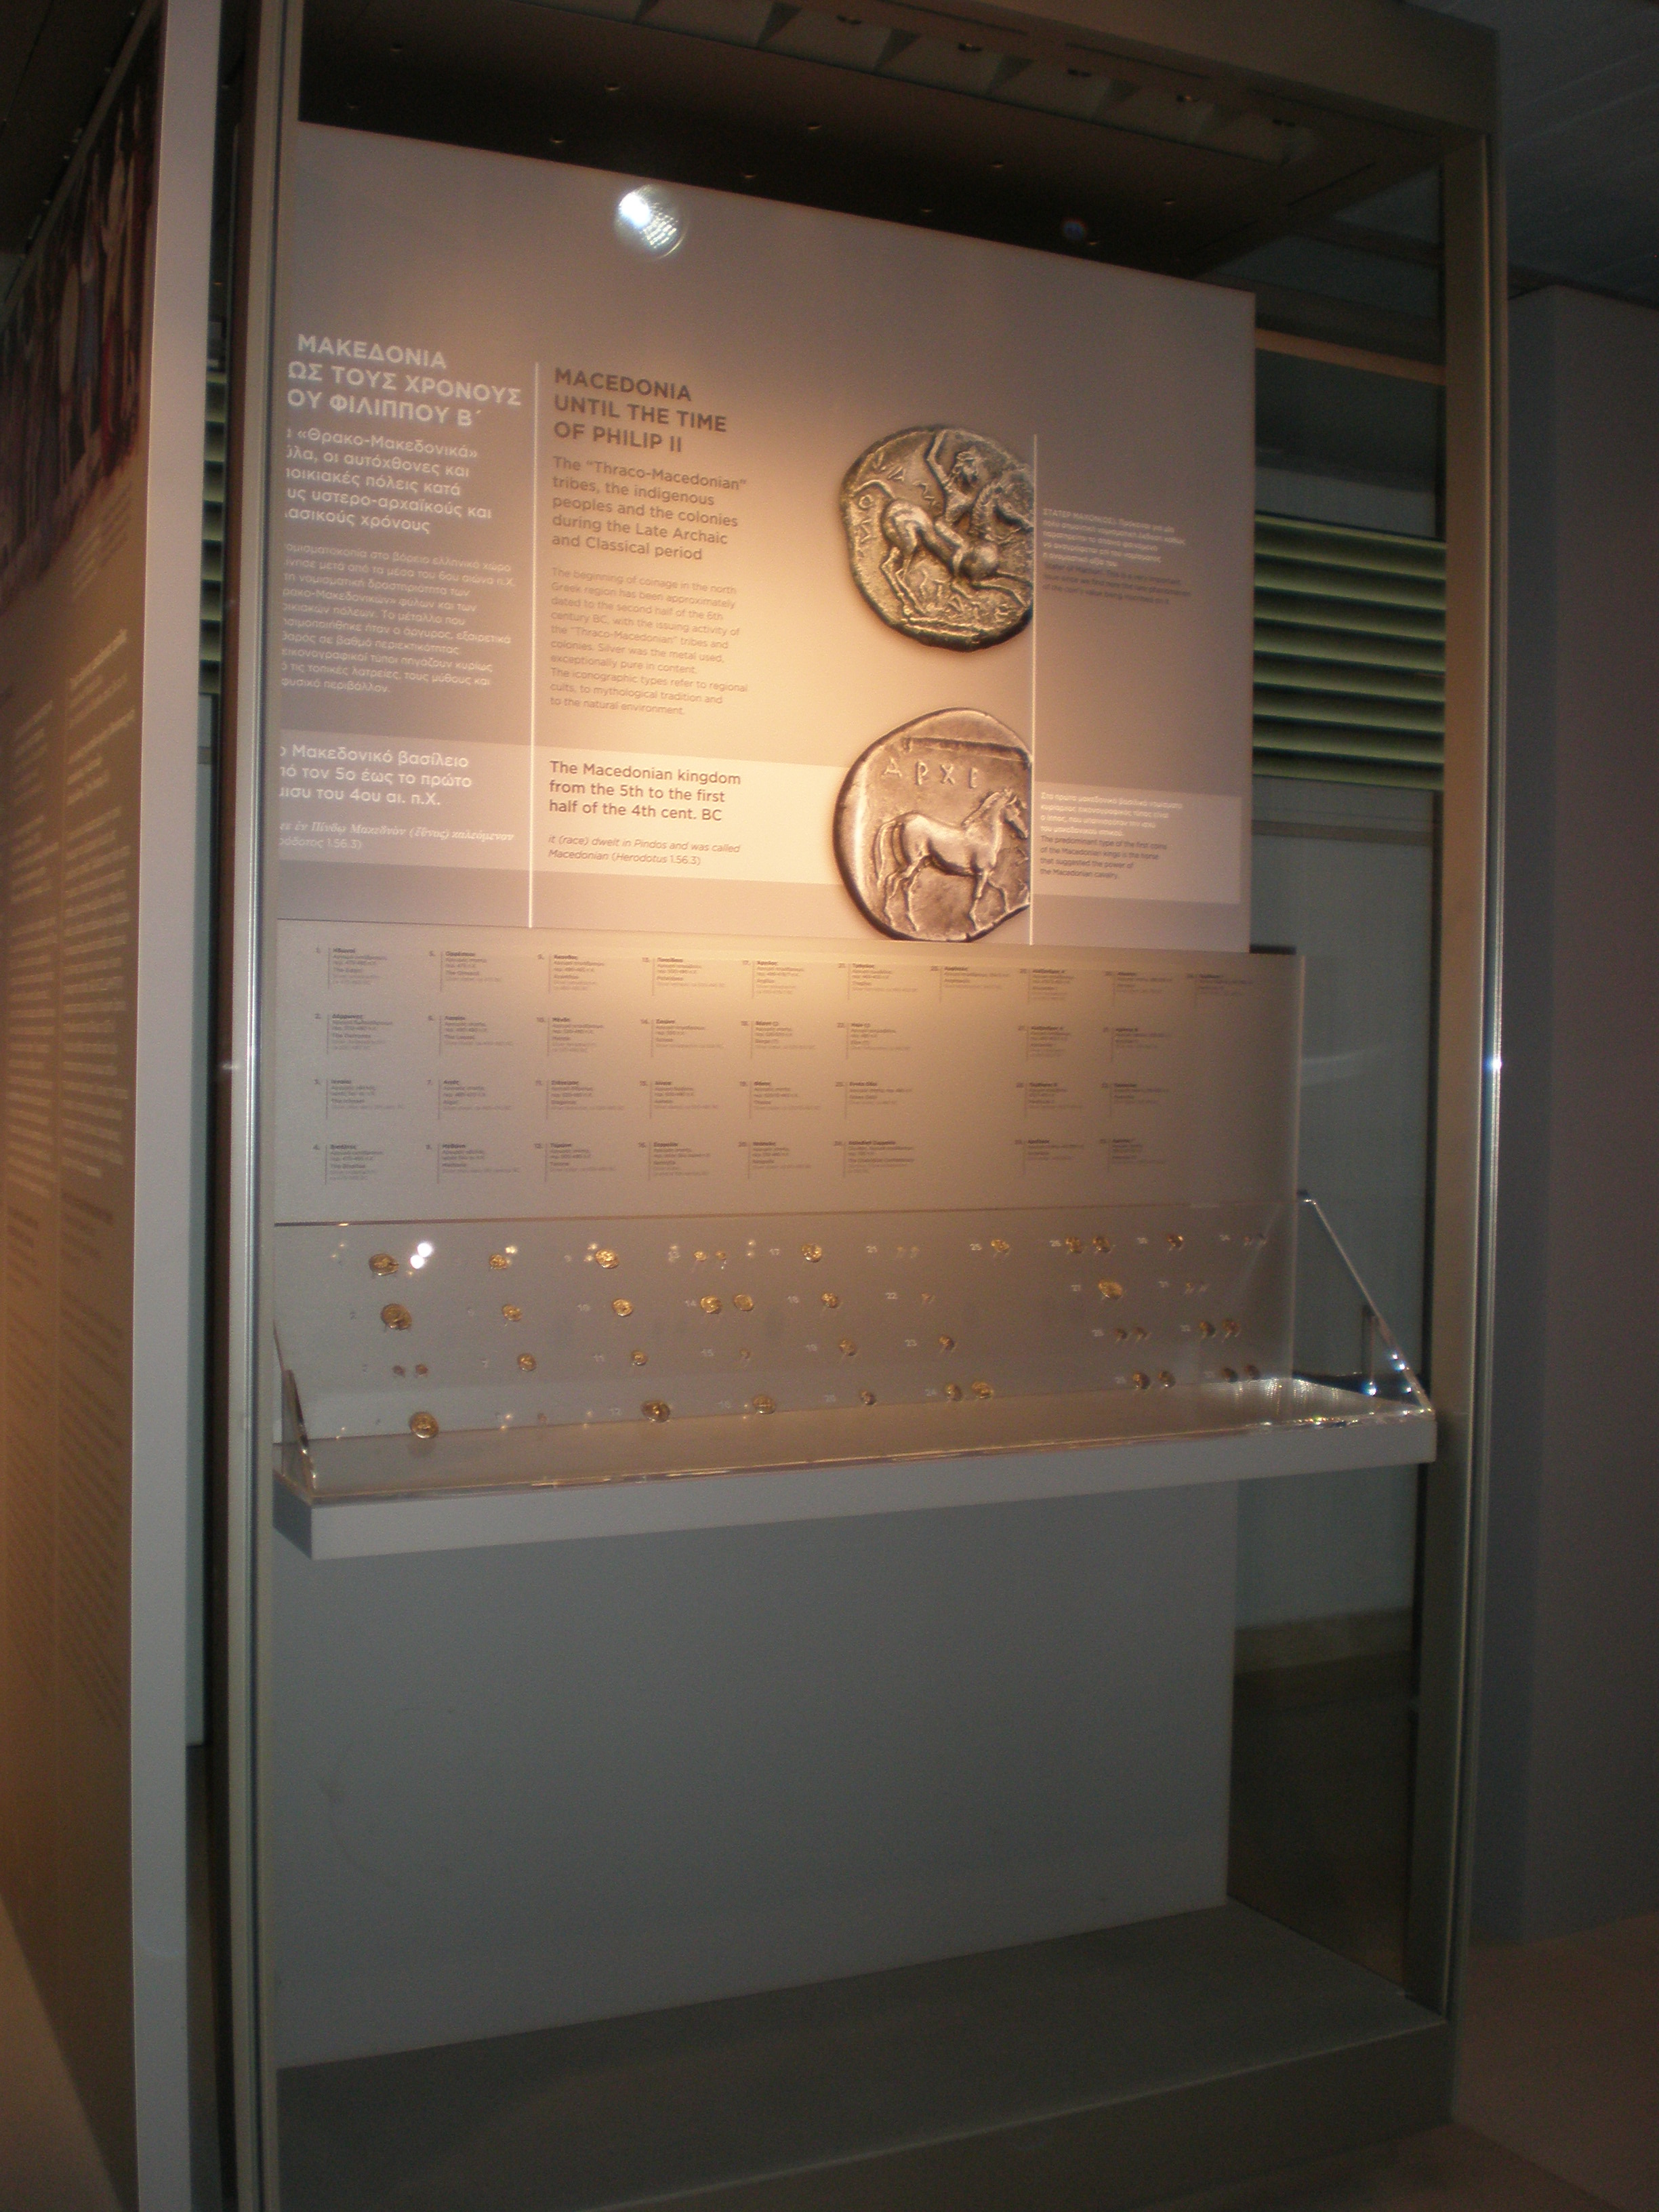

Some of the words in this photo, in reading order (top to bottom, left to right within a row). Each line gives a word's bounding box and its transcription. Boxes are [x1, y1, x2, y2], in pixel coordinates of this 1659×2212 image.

[298, 334, 447, 369] ΜΑΚΕΔΟΝΙΑ
[331, 365, 397, 391] ΤΟΥΣ
[405, 375, 522, 406] ΧΡΟΝΟΥΣ
[554, 367, 692, 401] MACEDONIA
[329, 392, 450, 424] ΦΙΛΙΠΠΟΥ
[554, 394, 621, 419] UNTIL
[627, 403, 670, 425] THE
[676, 410, 727, 432] TIME
[553, 422, 586, 441] OF
[592, 426, 663, 450] PHILIP
[669, 435, 682, 453] II
[344, 452, 441, 478] αυτόχθονες
[445, 464, 470, 478] και
[552, 455, 581, 471] The
[365, 472, 419, 495] πόλεις
[423, 480, 462, 496] κατά
[552, 476, 600, 496] tribes,
[605, 482, 630, 496] the
[634, 485, 715, 506] indigenous
[467, 505, 493, 518] και
[552, 497, 613, 514] peoples
[617, 504, 645, 517] and
[649, 506, 674, 520] the
[678, 510, 739, 527] colonies
[360, 512, 431, 536] χρόνους
[552, 513, 602, 534] during
[607, 520, 631, 534] the
[636, 522, 668, 538] Late
[672, 526, 729, 544] Archaic
[552, 534, 580, 548] and
[585, 536, 650, 554] Classical
[654, 546, 703, 560] period
[551, 567, 571, 578] The
[626, 575, 638, 585] of
[691, 581, 708, 592] the
[710, 584, 737, 594] north
[550, 596, 581, 608] dated
[583, 599, 594, 609] to
[597, 600, 614, 611] the
[616, 604, 652, 615] second
[675, 608, 686, 617] of
[688, 609, 705, 619] the
[583, 586, 617, 598] region
[619, 588, 636, 598] has
[638, 590, 663, 601] been
[665, 594, 735, 611] approximately
[550, 624, 568, 634] the
[680, 636, 708, 647] tribes
[710, 639, 729, 649] and
[612, 616, 634, 627] with
[636, 618, 653, 628] the
[655, 619, 689, 634] issuing
[691, 624, 727, 638] activity
[729, 627, 740, 636] of
[550, 655, 618, 670] exceptionally
[620, 660, 644, 671] pure
[646, 660, 655, 670] in
[597, 642, 625, 654] Silver
[628, 647, 648, 656] was
[650, 648, 666, 658] the
[669, 650, 697, 661] metal
[550, 667, 569, 678] The
[640, 674, 668, 687] types
[670, 677, 694, 688] refer
[696, 679, 706, 689] to
[709, 680, 747, 693] regional
[549, 696, 562, 705] to
[563, 697, 581, 707] the
[583, 699, 618, 710] natural
[579, 684, 590, 694] to
[593, 686, 657, 700] mythological
[660, 691, 702, 703] tradition
[704, 695, 724, 704] and
[292, 744, 393, 764] Μακεδονικό
[397, 750, 470, 768] βασίλειο
[302, 768, 330, 779] τον
[335, 766, 356, 781] 5ο
[361, 768, 394, 787] έως
[398, 773, 416, 784] το
[420, 773, 473, 790] πρώτο
[549, 760, 577, 775] The
[583, 762, 673, 781] Macedonian
[677, 768, 741, 787] kingdom
[316, 788, 345, 800] του
[349, 787, 382, 802] 4ου
[386, 792, 406, 803] αι.
[548, 779, 586, 795] from
[590, 782, 615, 796] the
[619, 783, 644, 798] 5th
[648, 786, 664, 799] to
[668, 787, 693, 801] the
[697, 788, 726, 803] first
[548, 798, 578, 813] half
[581, 801, 598, 815] of
[602, 802, 627, 816] the
[631, 803, 656, 818] 4th
[661, 807, 697, 820] cent.
[701, 807, 722, 821] BC
[548, 848, 609, 861] Macedonian
[611, 851, 668, 864] (Herodotus
[591, 836, 619, 846] dwelt
[621, 838, 632, 847] in
[634, 838, 667, 849] Pindos
[669, 841, 689, 851] and
[690, 843, 710, 852] was
[712, 843, 741, 853] called
